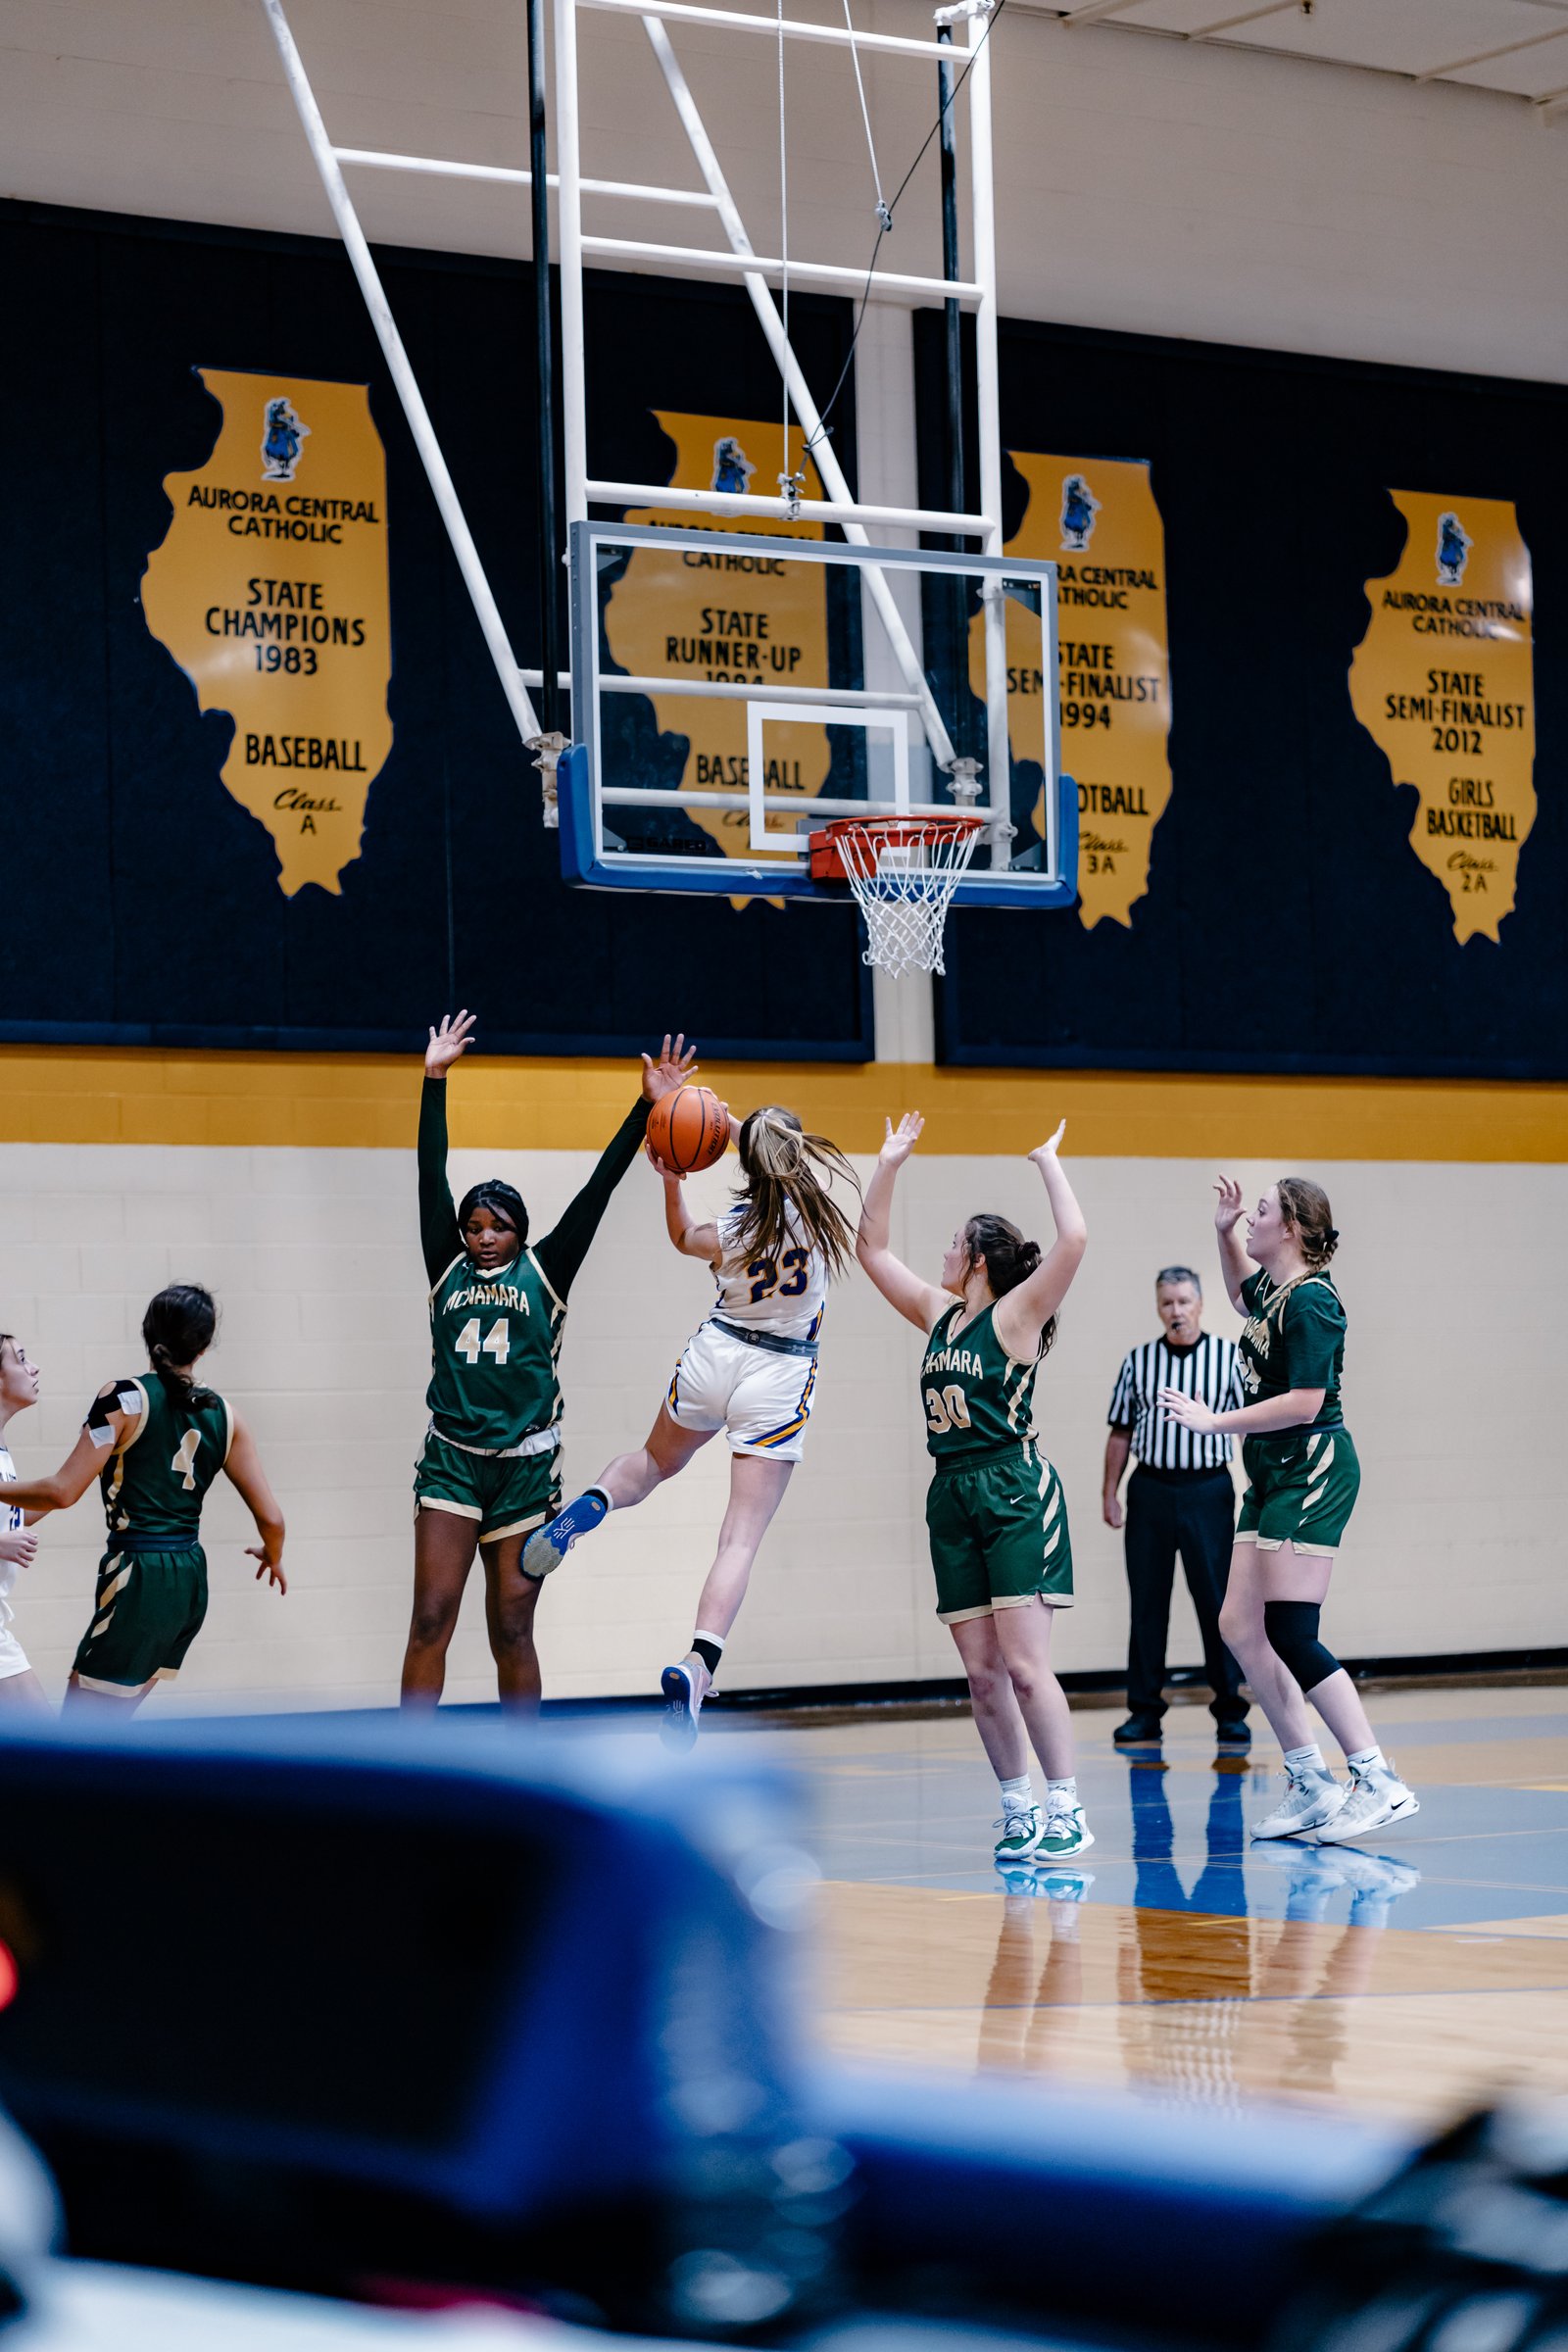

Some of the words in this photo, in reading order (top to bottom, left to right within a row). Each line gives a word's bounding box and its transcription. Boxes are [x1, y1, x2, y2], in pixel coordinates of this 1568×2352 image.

[187, 485, 281, 514] AURORA
[285, 496, 379, 523] CENTRAL
[228, 515, 343, 544] CATHOLIC
[683, 551, 786, 576] CATHOLIC
[1081, 565, 1159, 591] CENTRAL
[248, 578, 322, 610] STATE
[1057, 586, 1128, 610] THOLIC
[1382, 590, 1451, 613] AURORA
[1455, 598, 1526, 622] CENTRAL
[206, 607, 366, 646] CHAMPIONS
[701, 608, 769, 639] STATE
[255, 644, 318, 675] 1983
[665, 636, 802, 673] RUNNER-UP
[1428, 669, 1485, 698] STATE
[1386, 693, 1526, 730] SEMI-FINALIST
[246, 734, 368, 772] BASEBALL
[1432, 726, 1484, 755] 2012
[697, 755, 806, 790] BASEALL
[273, 788, 342, 811] Class
[1077, 784, 1150, 815] OTBALL
[1449, 777, 1494, 808] GIRLS
[301, 813, 317, 836] A
[1427, 808, 1517, 841] BASKETBALL
[748, 1247, 810, 1303] 23
[455, 1318, 510, 1365] 44
[926, 1384, 971, 1434] 30
[172, 1429, 202, 1491] 4
